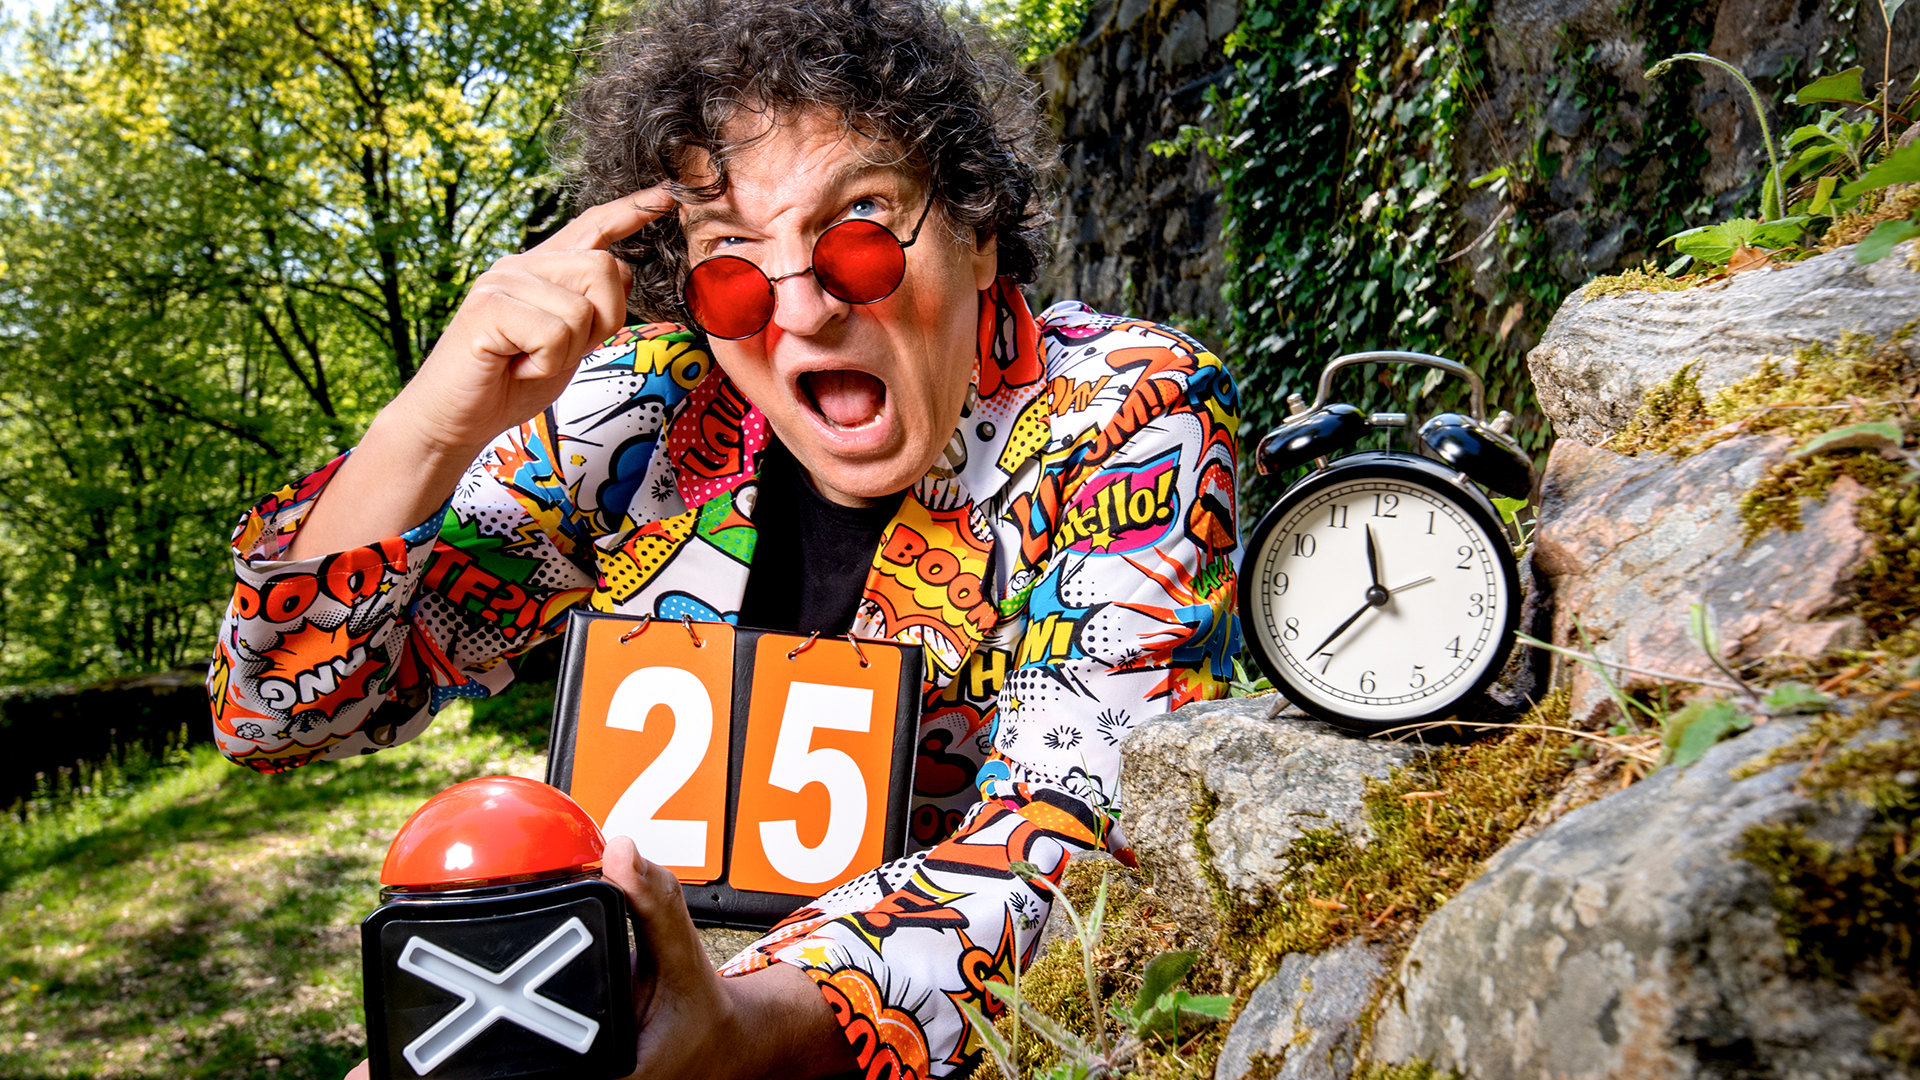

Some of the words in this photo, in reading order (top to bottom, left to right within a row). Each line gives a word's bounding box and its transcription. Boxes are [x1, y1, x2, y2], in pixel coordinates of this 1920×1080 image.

[1054, 470, 1175, 552] Hello!
[1327, 503, 1350, 530] 11
[1371, 493, 1400, 519] 12
[1425, 511, 1436, 536] 1
[1292, 533, 1317, 559] 10
[1456, 545, 1474, 571] 2
[1272, 571, 1290, 597] 9
[1467, 592, 1485, 619] 3
[1283, 616, 1300, 642] 8
[1445, 635, 1464, 660] 4
[1319, 651, 1335, 676] 7
[1359, 670, 1377, 695] 6
[1409, 664, 1426, 690] 5
